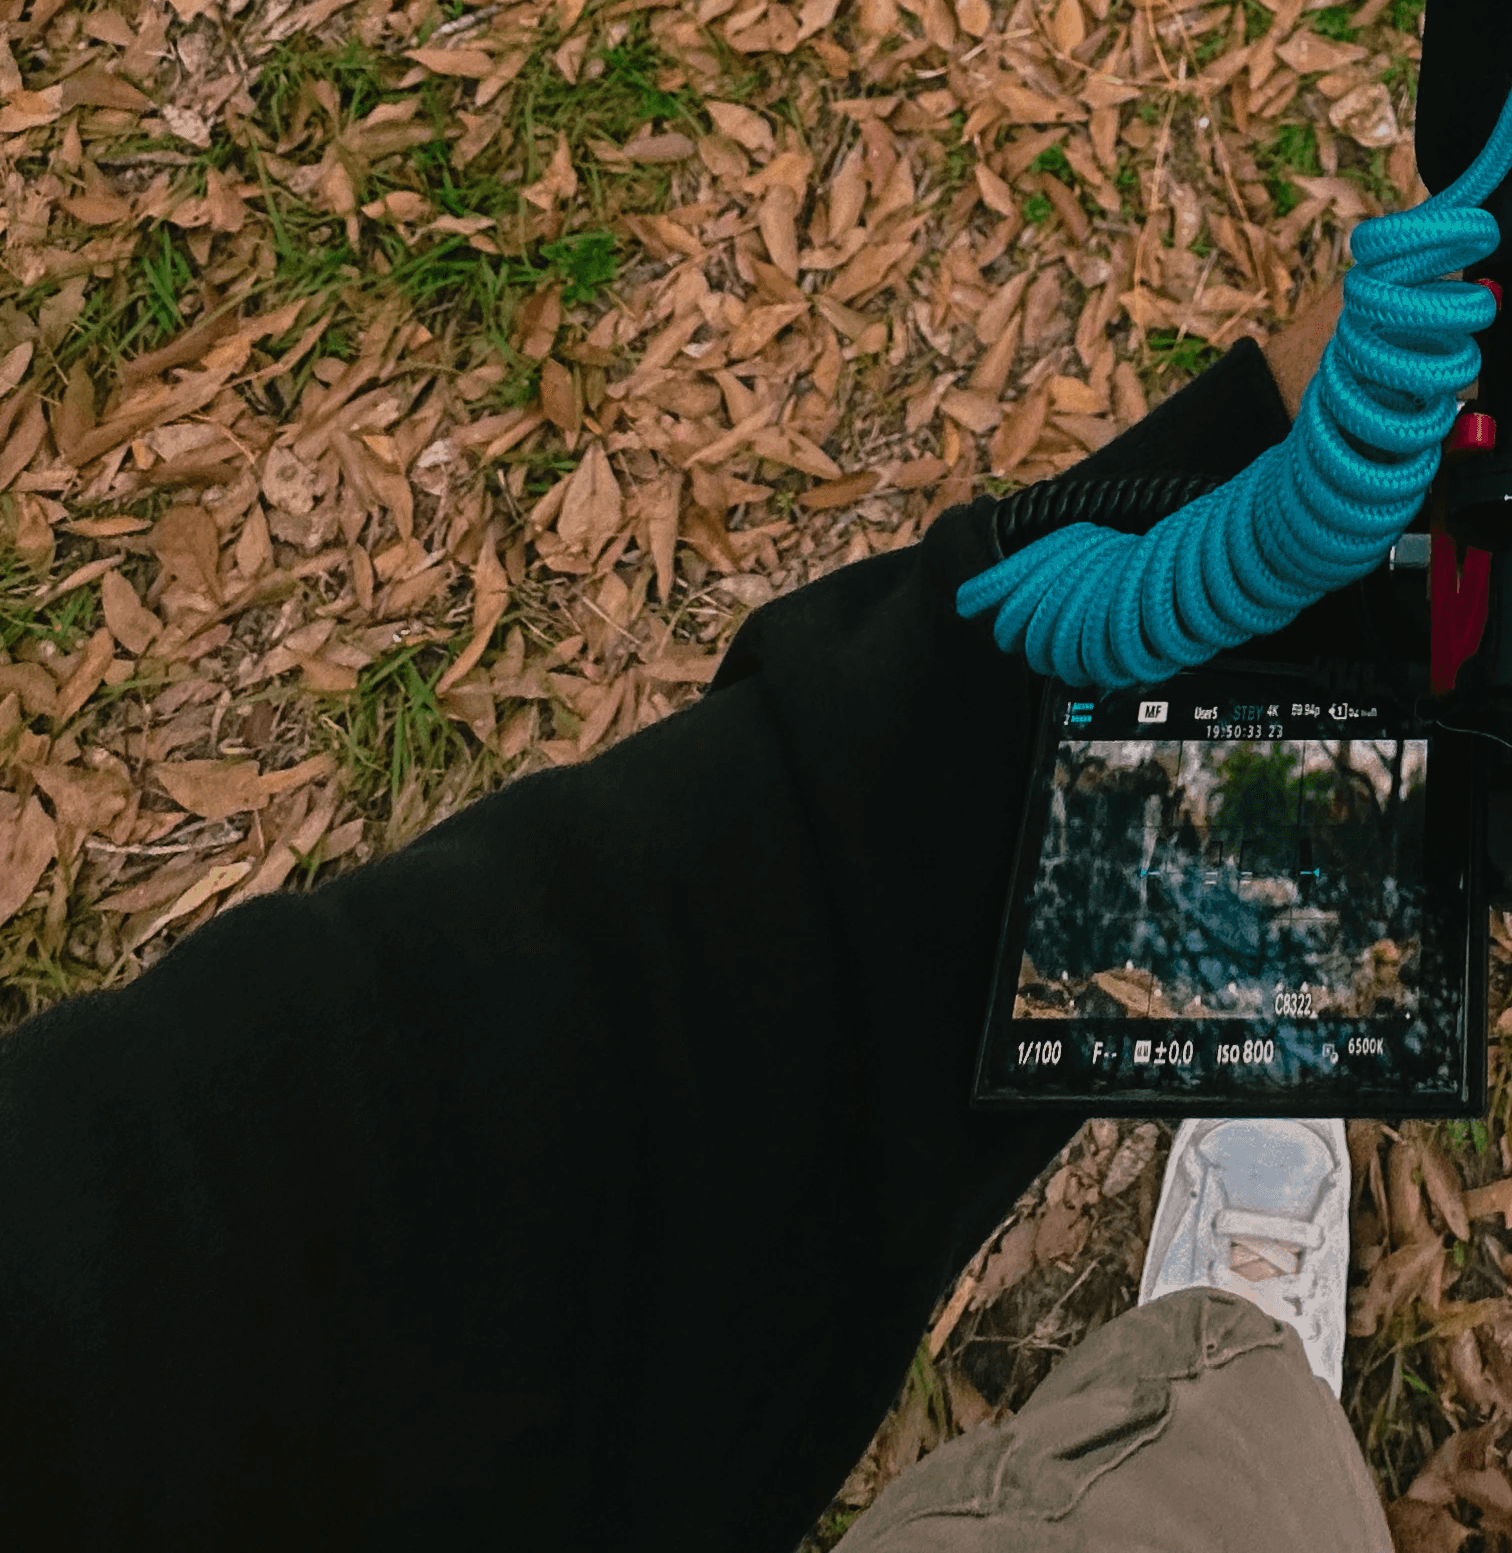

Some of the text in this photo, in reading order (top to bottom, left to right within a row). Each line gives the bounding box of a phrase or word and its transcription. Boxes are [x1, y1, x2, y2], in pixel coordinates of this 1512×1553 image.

[1144, 704, 1163, 719] MF
[1233, 705, 1264, 721] STBY
[1274, 992, 1312, 1016] C8322
[1018, 1040, 1062, 1065] 1/100
[1242, 1039, 1274, 1066] 800
[1348, 1037, 1384, 1055] 6500K
